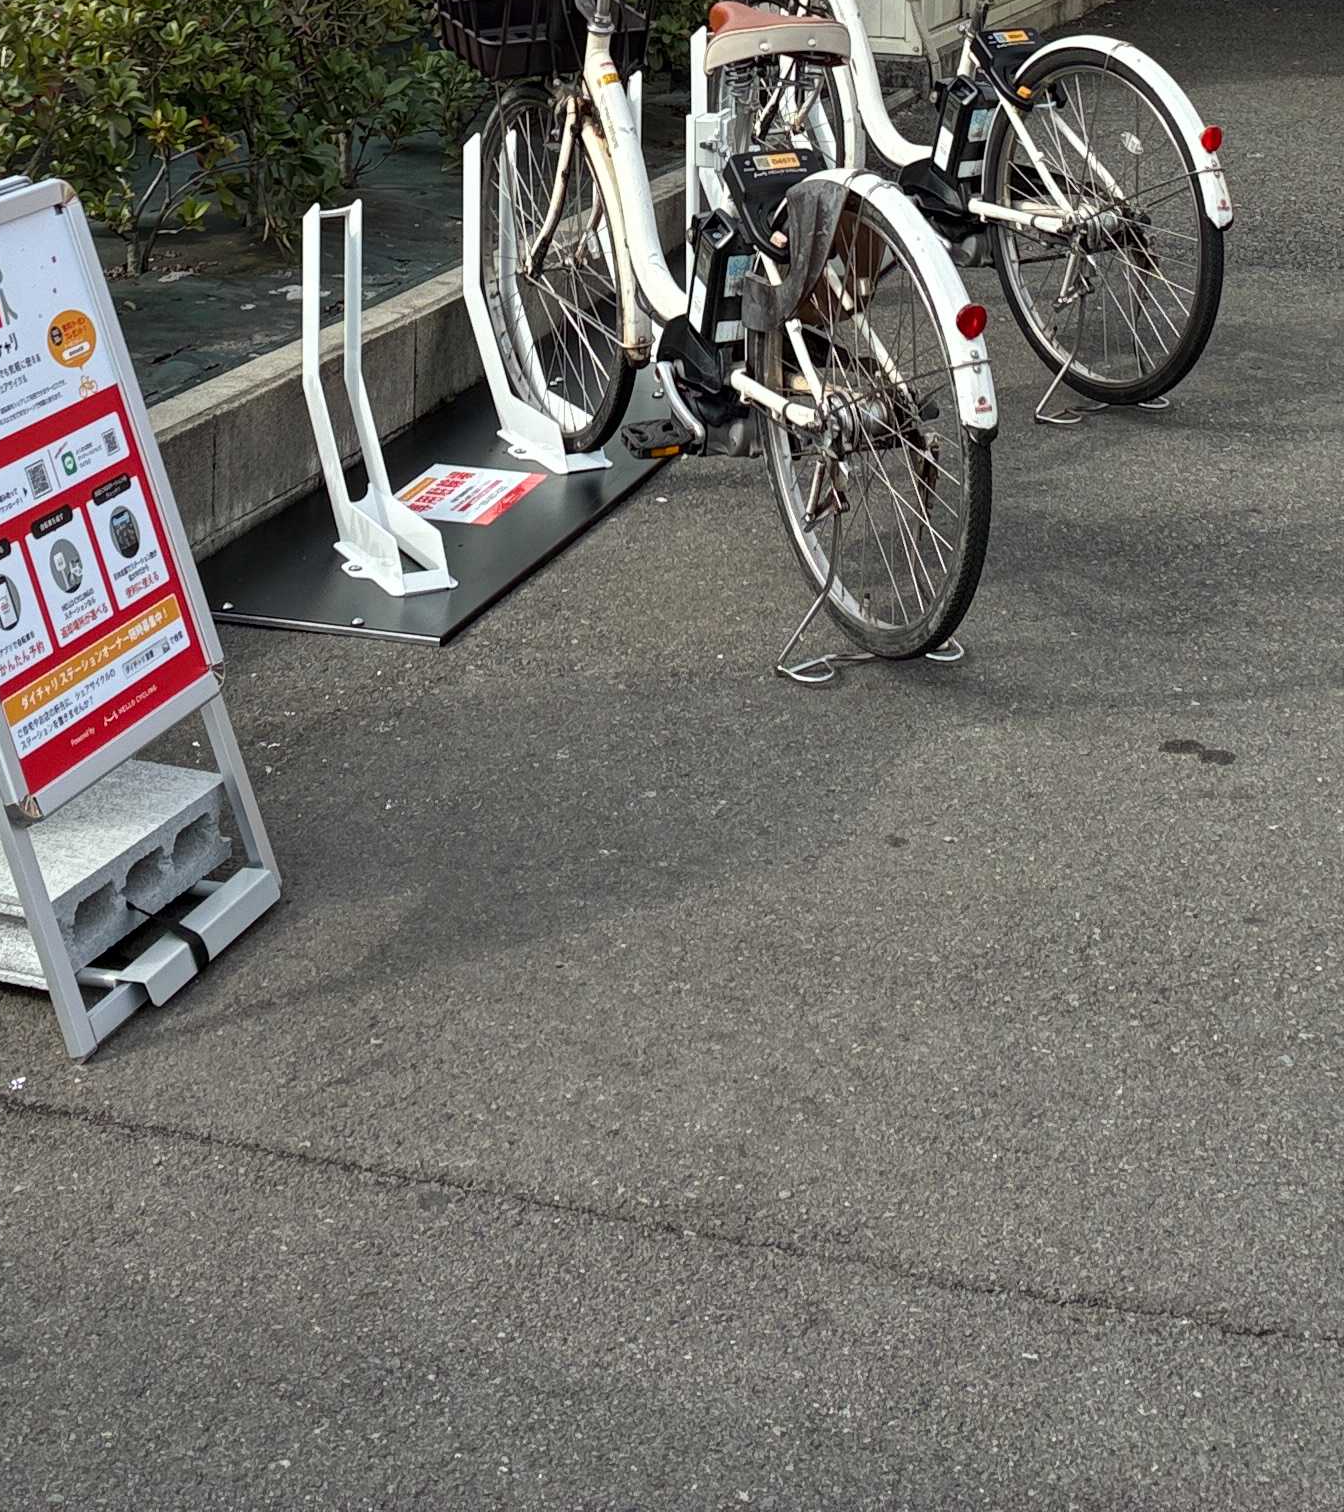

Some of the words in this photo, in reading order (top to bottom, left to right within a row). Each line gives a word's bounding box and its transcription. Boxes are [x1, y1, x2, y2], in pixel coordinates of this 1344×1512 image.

[0, 639, 45, 677] かんたん予約
